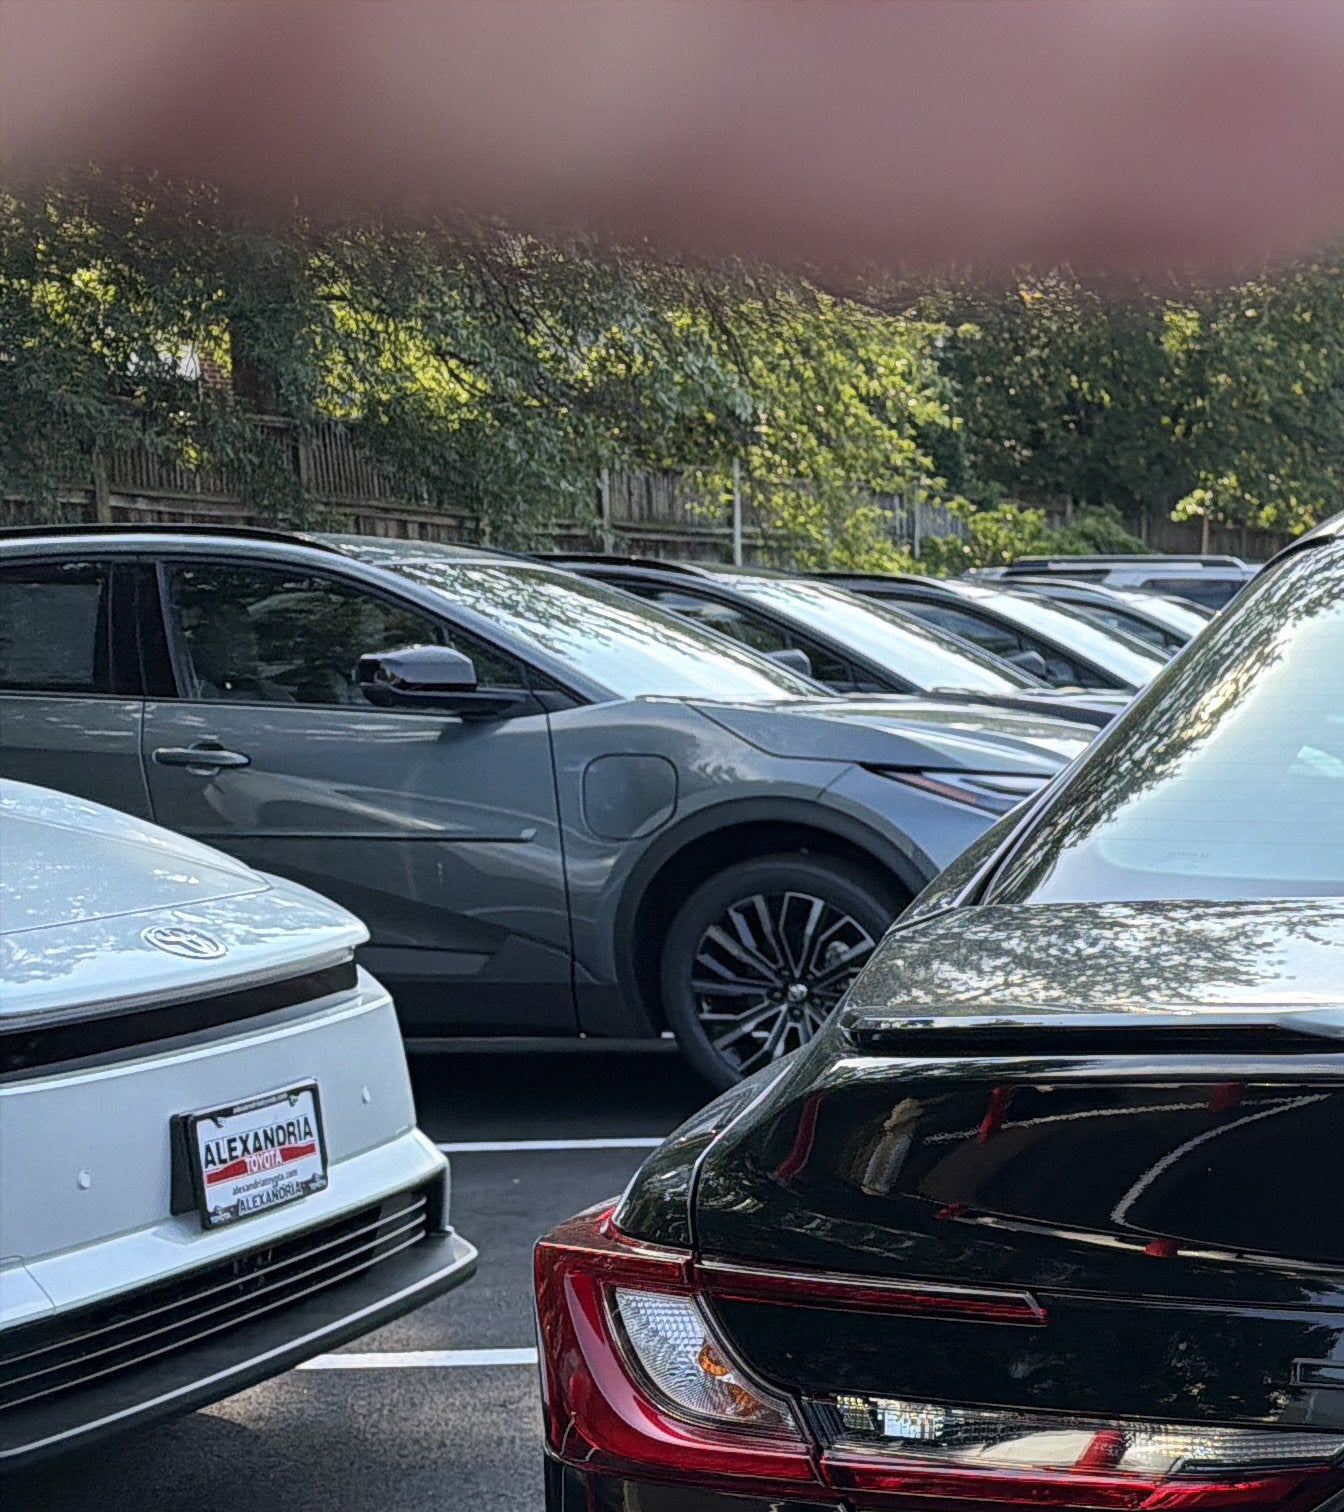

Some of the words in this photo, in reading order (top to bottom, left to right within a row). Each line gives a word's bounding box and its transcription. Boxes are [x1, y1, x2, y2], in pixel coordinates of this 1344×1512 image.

[204, 1116, 313, 1169] ALEXANDRIA
[246, 1150, 283, 1173] TOYOTA
[240, 1182, 301, 1213] ALEXANDRIA
